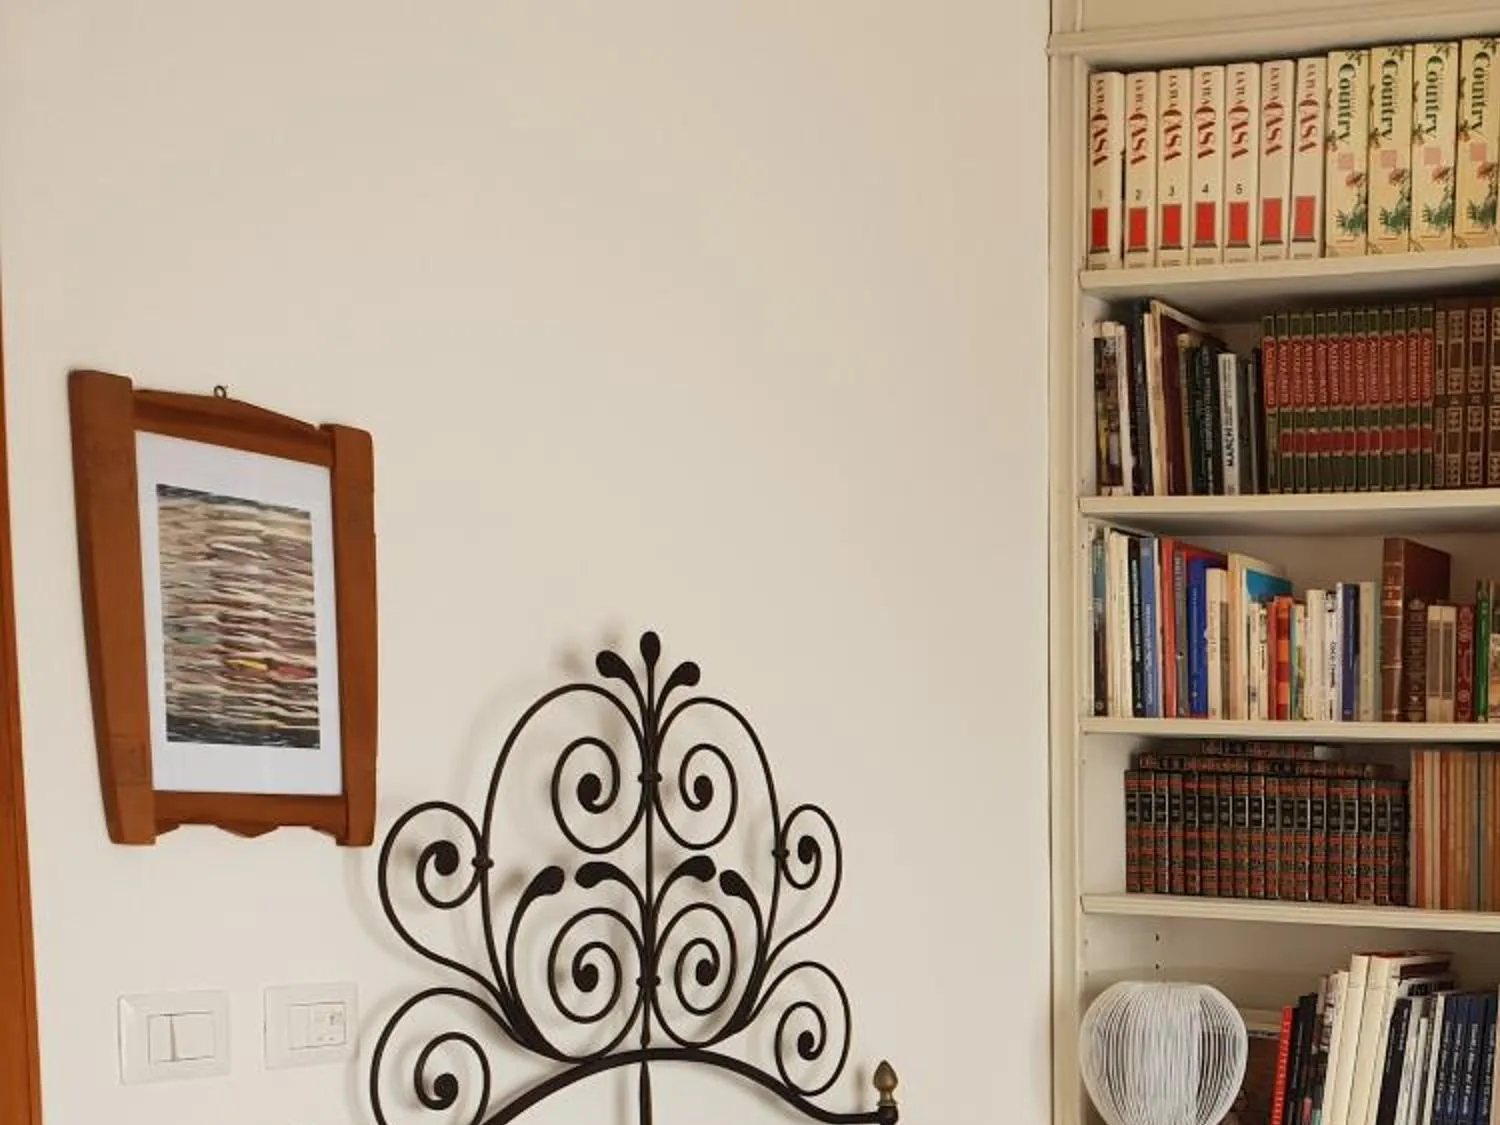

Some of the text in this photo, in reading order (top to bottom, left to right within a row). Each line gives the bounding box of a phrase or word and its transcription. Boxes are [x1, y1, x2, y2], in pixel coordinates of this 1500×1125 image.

[1337, 63, 1355, 144] Country
[1381, 59, 1399, 140] Country
[1425, 56, 1444, 136] Country
[1470, 51, 1491, 132] Country
[1092, 114, 1108, 167] CASA
[1129, 113, 1148, 165] CASA
[1162, 110, 1182, 161] CASA
[1196, 106, 1216, 159] CASA
[1228, 105, 1250, 159] CASA
[1264, 102, 1284, 156] CASA
[1299, 100, 1320, 152] CASA
